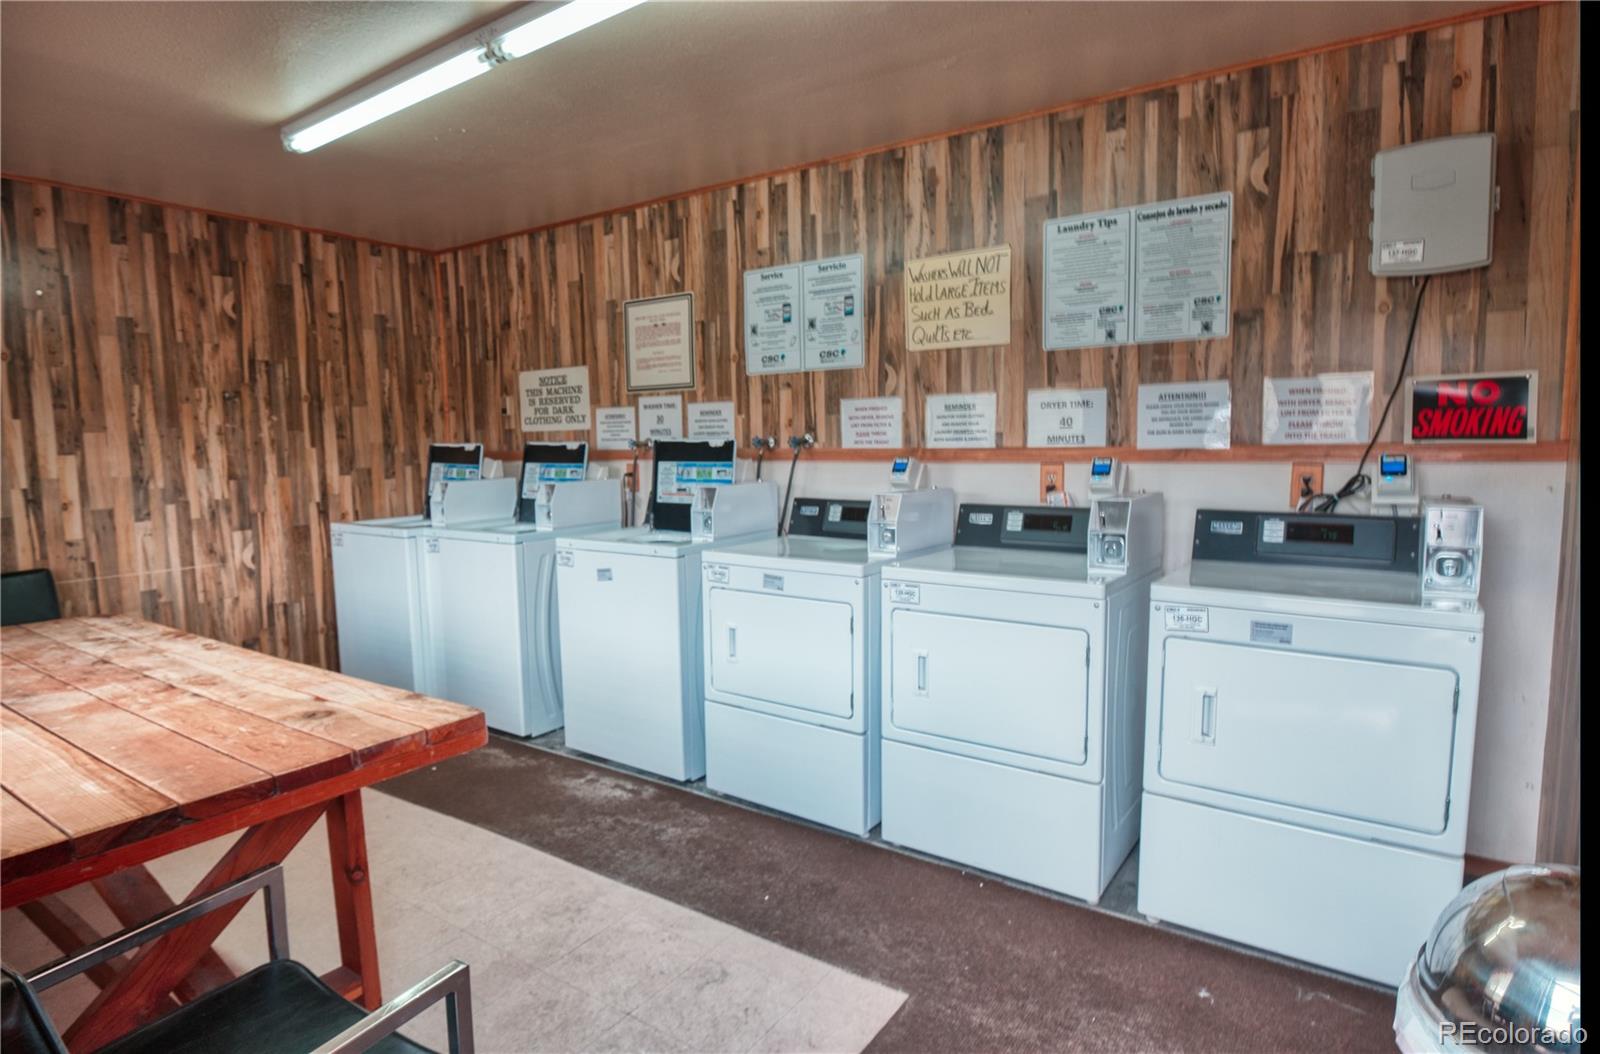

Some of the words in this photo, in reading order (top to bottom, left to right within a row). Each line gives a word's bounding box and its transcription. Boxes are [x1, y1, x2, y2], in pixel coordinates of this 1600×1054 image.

[1137, 210, 1166, 222] Consejos
[1167, 208, 1175, 217] de
[1176, 205, 1198, 215] lavado
[1199, 205, 1203, 215] y
[1205, 200, 1228, 211] secado
[1057, 221, 1095, 234] Laundry
[1098, 218, 1118, 229] Tips
[818, 263, 847, 272] Servicio
[975, 254, 1001, 275] NOT
[760, 272, 783, 281] Service
[935, 283, 969, 301] LARGE
[761, 355, 780, 364] CSC
[819, 350, 839, 359] CSC
[539, 374, 567, 386] NOTICE
[525, 388, 543, 398] THIS
[546, 385, 583, 396] MACHINE
[1437, 380, 1502, 408] NO
[528, 398, 536, 407] IS
[539, 395, 581, 406] RESERVED
[1040, 400, 1067, 410] DRYER
[1069, 399, 1094, 409] TIME:
[534, 407, 549, 415] FOR
[552, 406, 575, 415] DARK
[524, 416, 562, 425] CLOTHING
[565, 414, 587, 424] ONLY
[1059, 417, 1073, 427] 40
[1412, 405, 1527, 438] SMOKING
[1047, 434, 1086, 444] MINUTES
